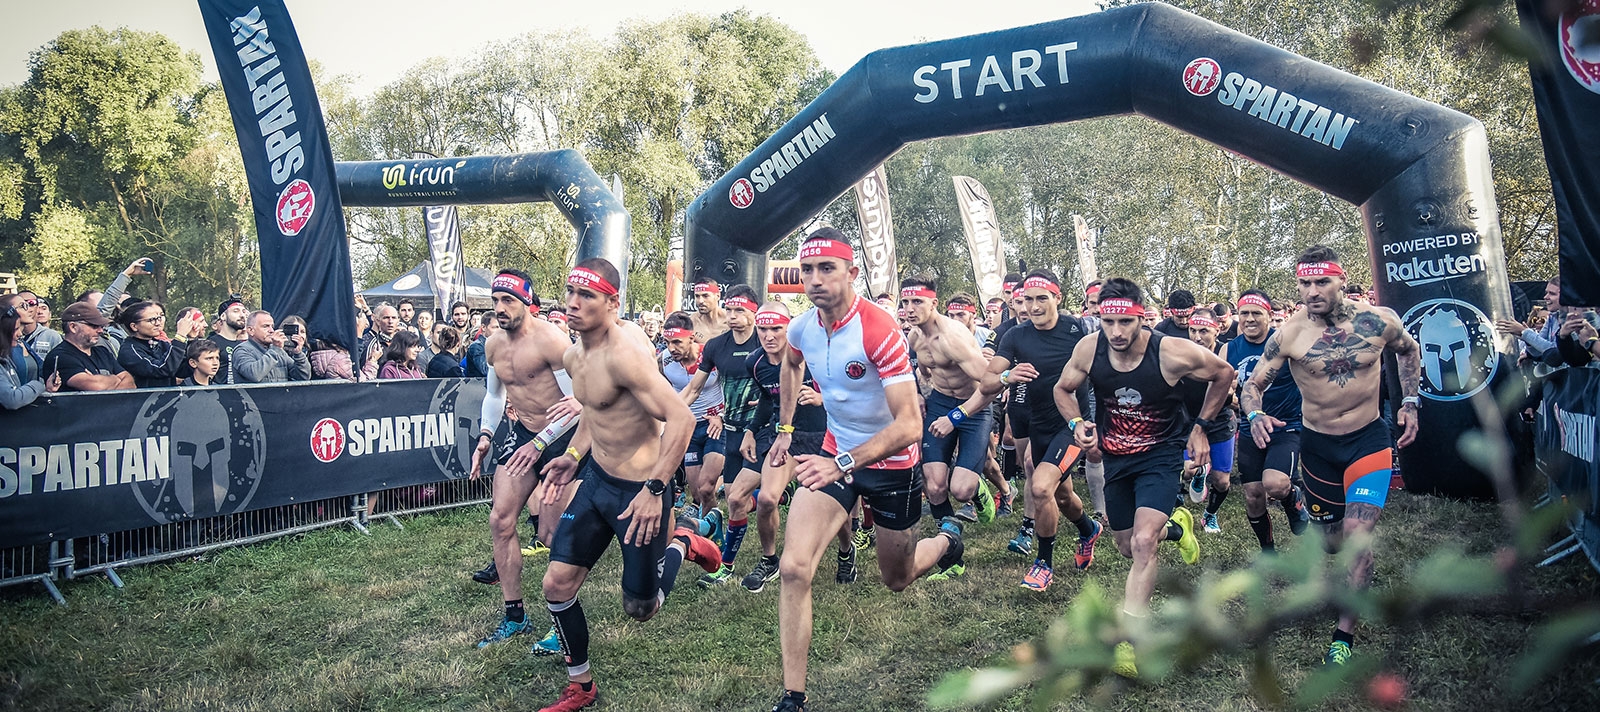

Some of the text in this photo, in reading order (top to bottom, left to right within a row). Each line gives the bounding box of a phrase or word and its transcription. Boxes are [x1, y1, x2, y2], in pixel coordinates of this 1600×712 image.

[230, 6, 304, 185] SPARTAN
[913, 41, 1078, 103] START
[1217, 72, 1356, 151] SPARTAN
[750, 114, 836, 193] SPARTAN
[862, 170, 890, 286] Rakute
[1383, 231, 1480, 256] POWERED BY
[1386, 253, 1485, 283] Rakuten
[348, 412, 454, 456] SPARTAN
[0, 435, 169, 498] SPARTAN
